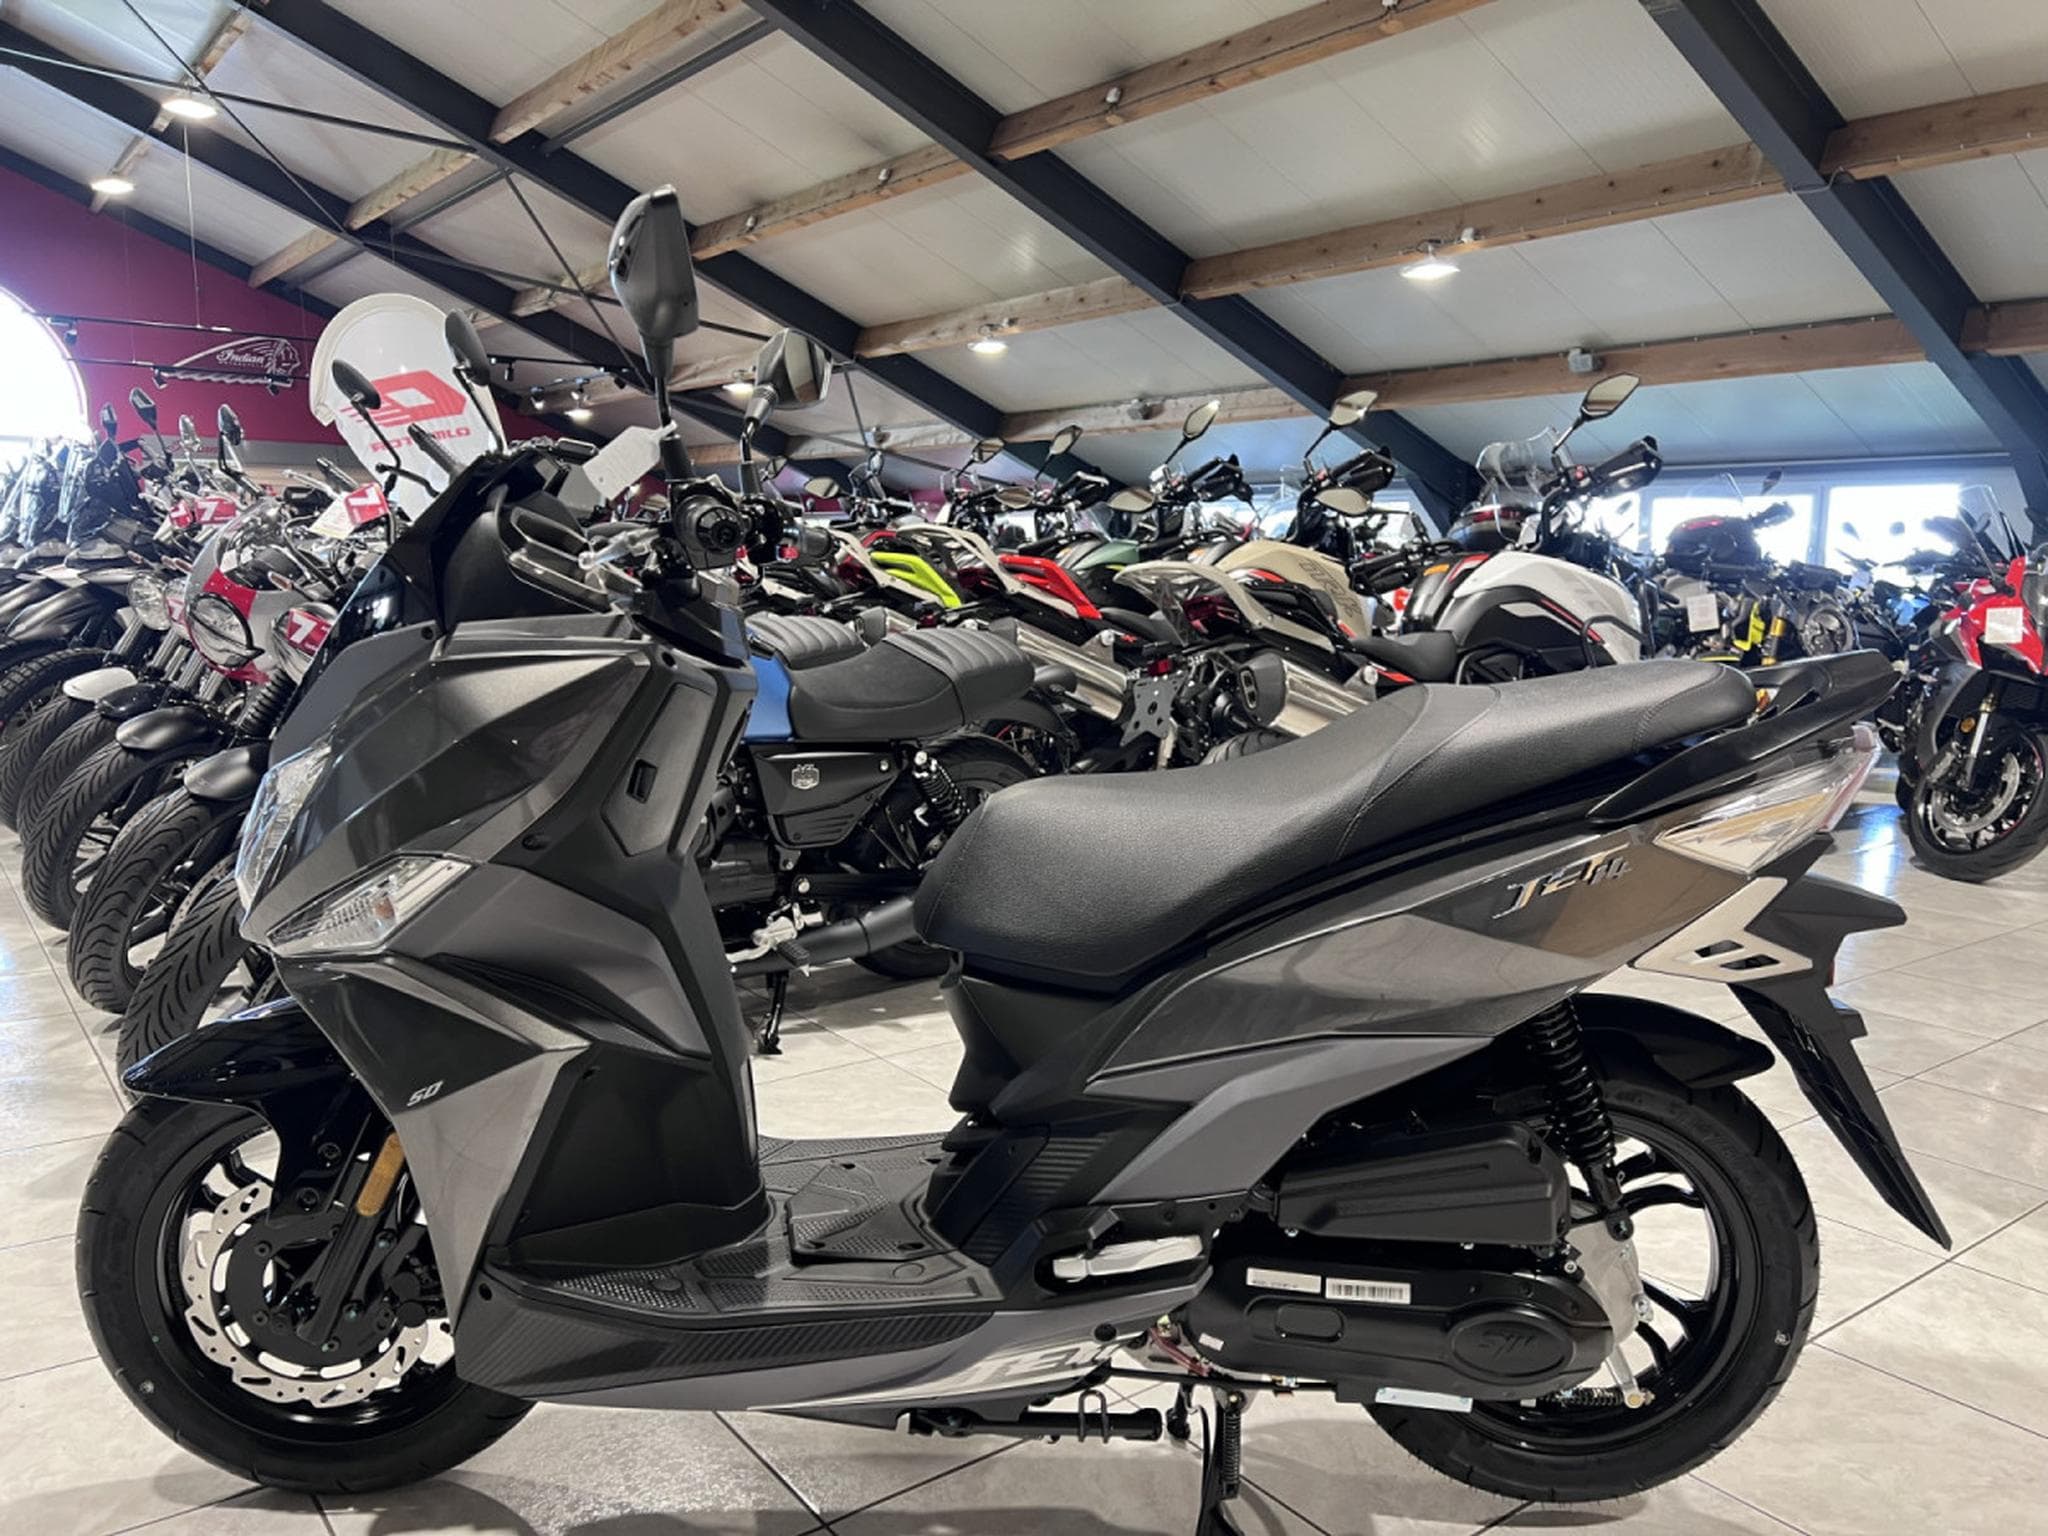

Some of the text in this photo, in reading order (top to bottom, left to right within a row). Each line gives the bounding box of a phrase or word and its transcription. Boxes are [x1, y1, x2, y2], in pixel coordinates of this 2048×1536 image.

[216, 349, 265, 365] Indian
[289, 612, 318, 645] 7
[407, 1080, 444, 1107] 50
